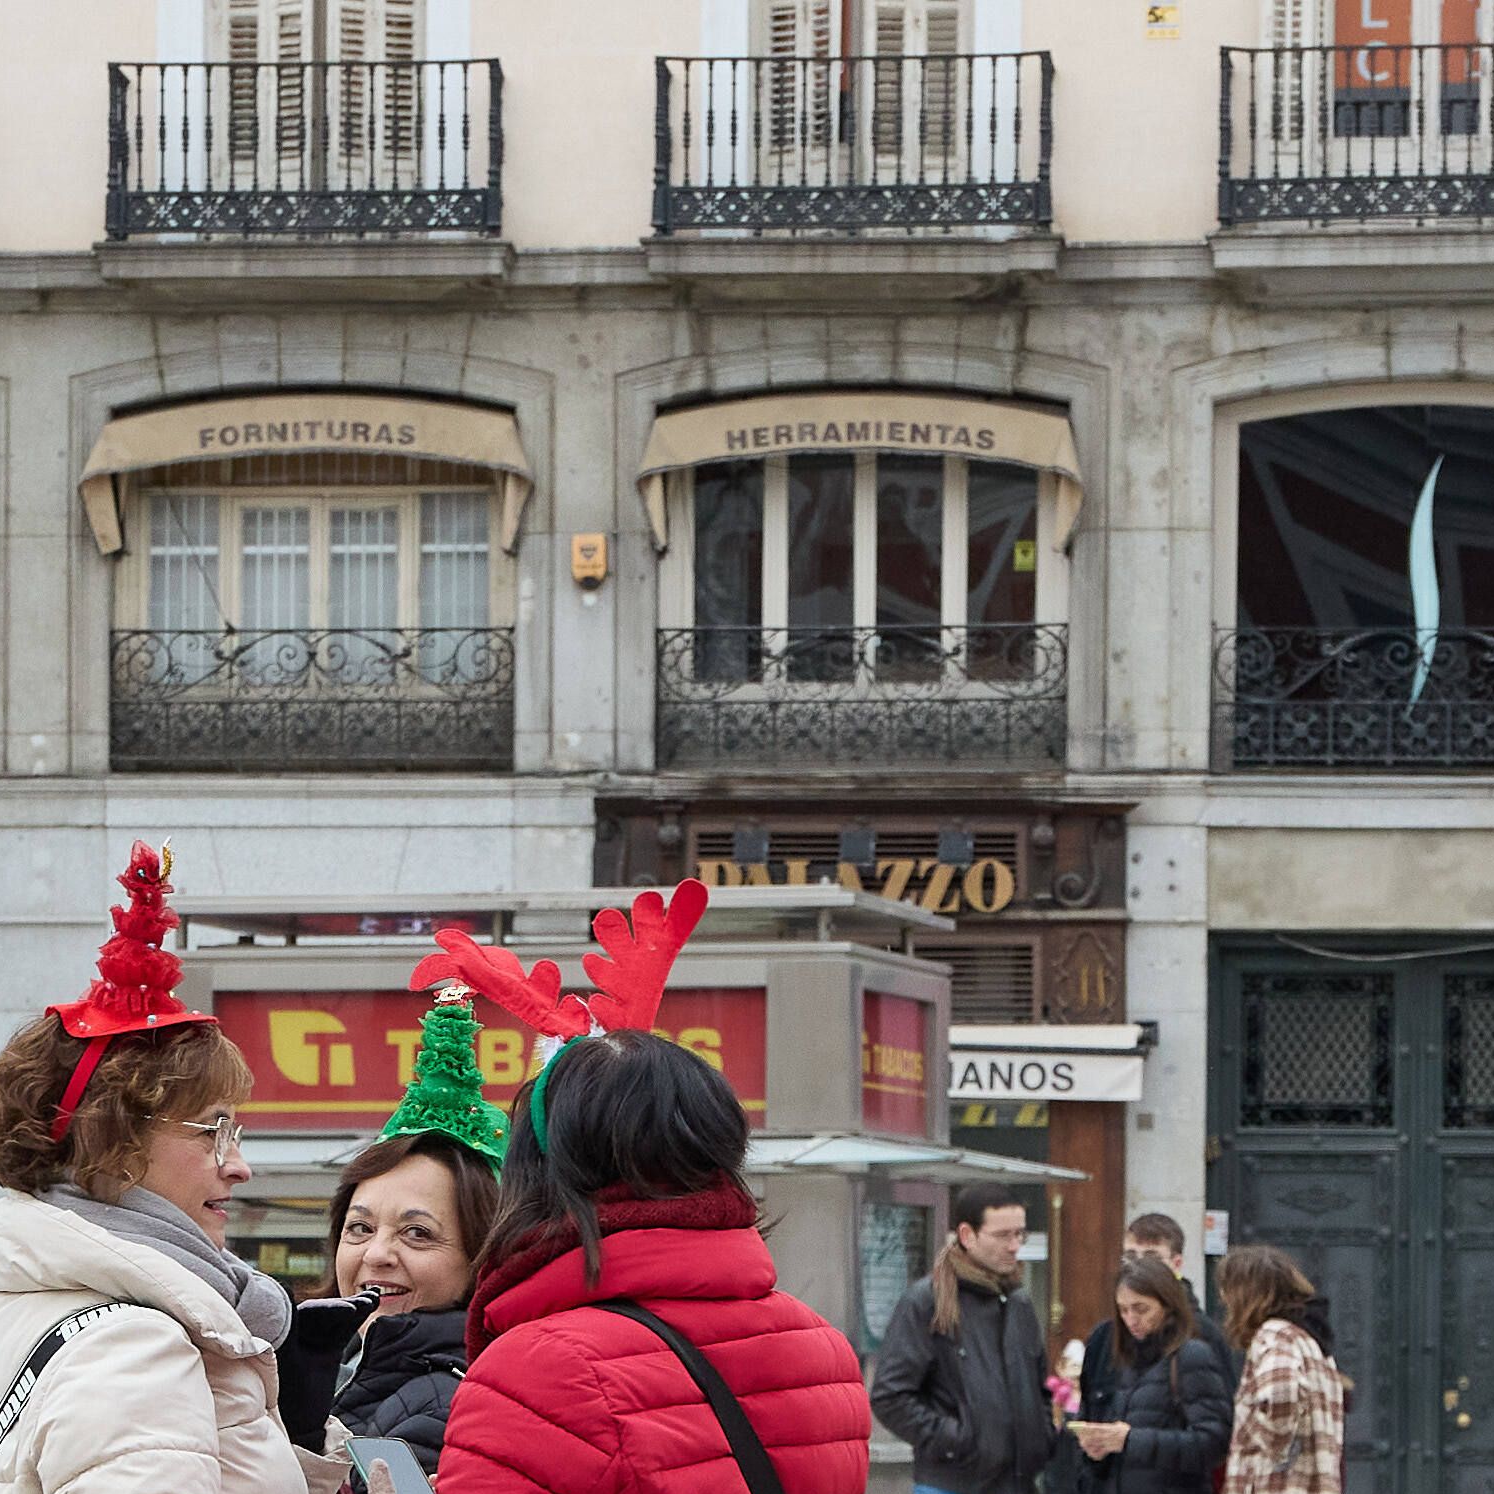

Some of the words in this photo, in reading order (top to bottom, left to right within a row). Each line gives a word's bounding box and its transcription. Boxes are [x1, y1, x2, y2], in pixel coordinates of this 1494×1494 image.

[198, 420, 417, 449] FORNITURAS
[726, 420, 997, 450] HERRAMIENTAS
[949, 1062, 1075, 1092] ANOS
